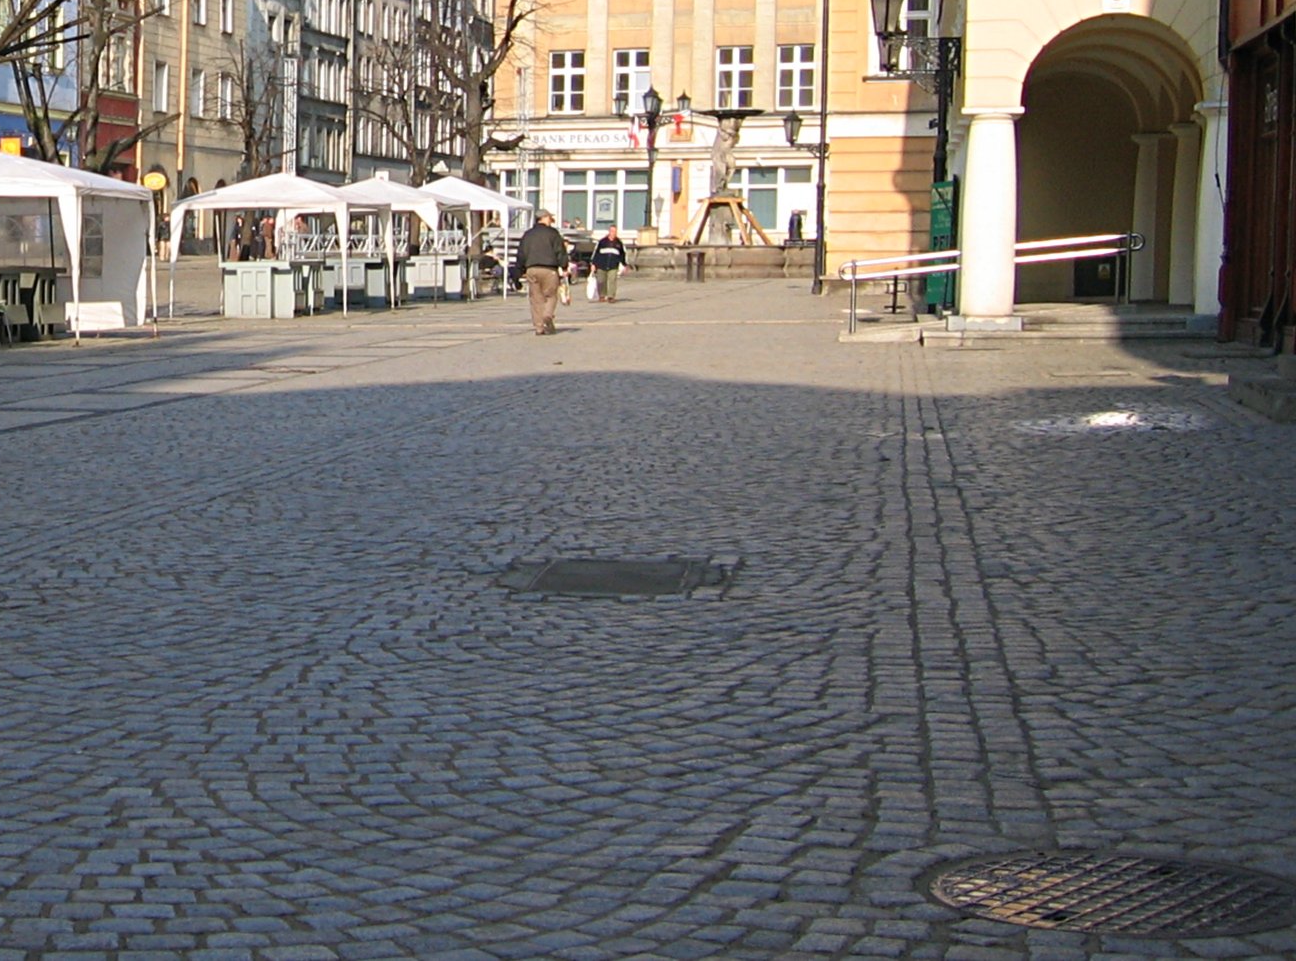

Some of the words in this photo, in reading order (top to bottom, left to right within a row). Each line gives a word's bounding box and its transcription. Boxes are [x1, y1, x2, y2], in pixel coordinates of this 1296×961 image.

[532, 135, 566, 144] BANK
[569, 134, 610, 144] PEKAO
[612, 133, 629, 143] SA
